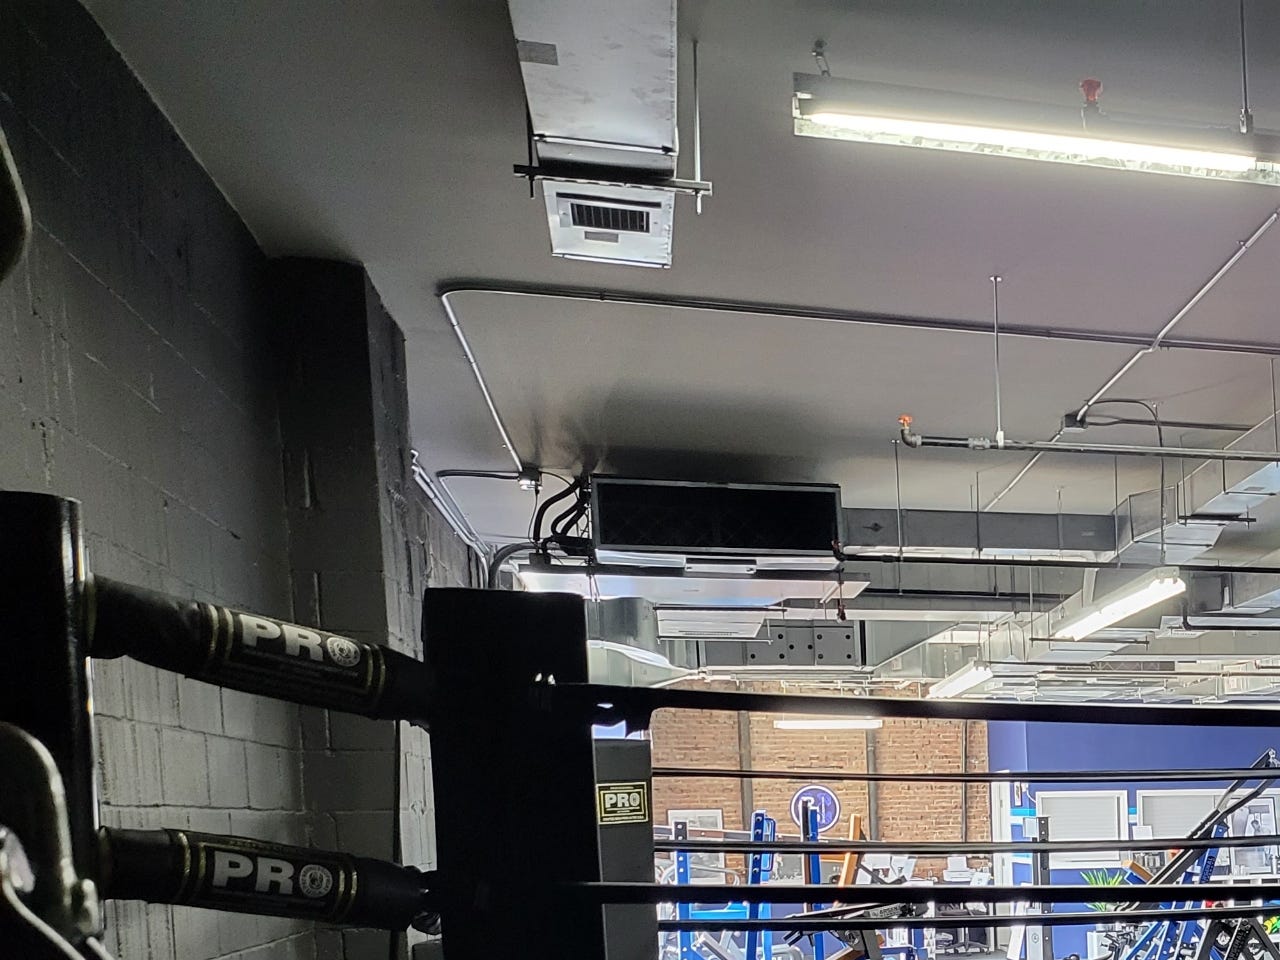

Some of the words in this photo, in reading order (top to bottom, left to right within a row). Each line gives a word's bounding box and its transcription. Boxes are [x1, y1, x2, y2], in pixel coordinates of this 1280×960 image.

[239, 614, 361, 667] PRO
[605, 792, 640, 808] PRO
[212, 850, 334, 898] PRO
